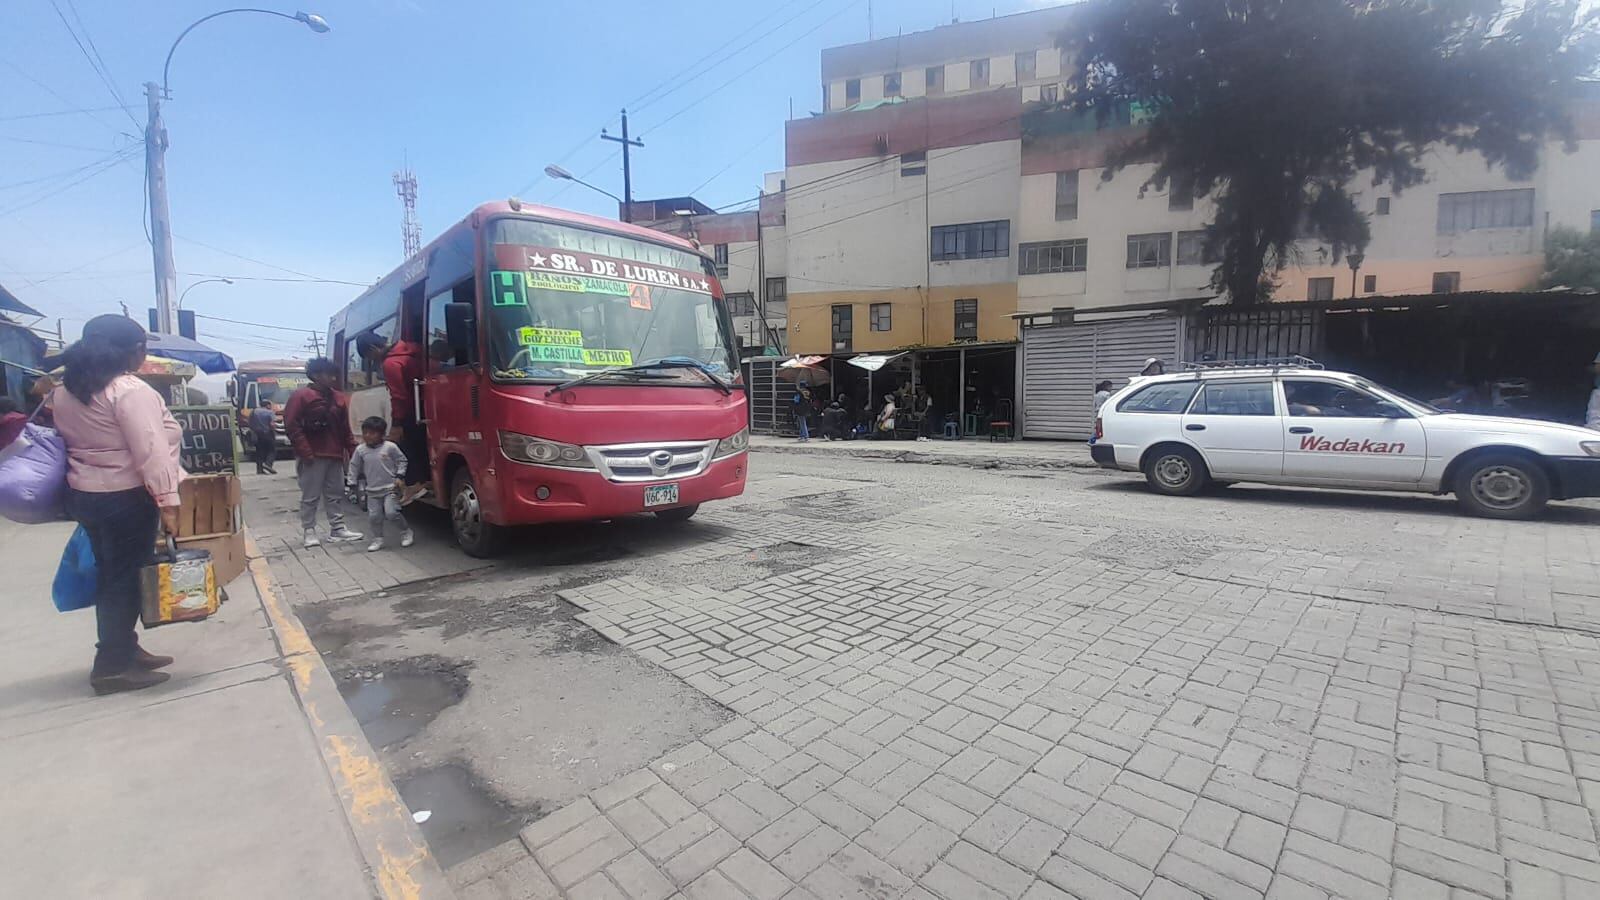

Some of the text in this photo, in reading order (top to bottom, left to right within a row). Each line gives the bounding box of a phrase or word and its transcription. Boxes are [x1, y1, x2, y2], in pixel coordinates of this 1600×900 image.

[550, 252, 585, 273] SR.
[590, 258, 619, 277] DE
[623, 264, 680, 285] LUREN
[493, 273, 525, 304] H
[544, 347, 582, 360] CASTILLA
[588, 350, 626, 363] METRO
[1300, 435, 1405, 454] Wadakan
